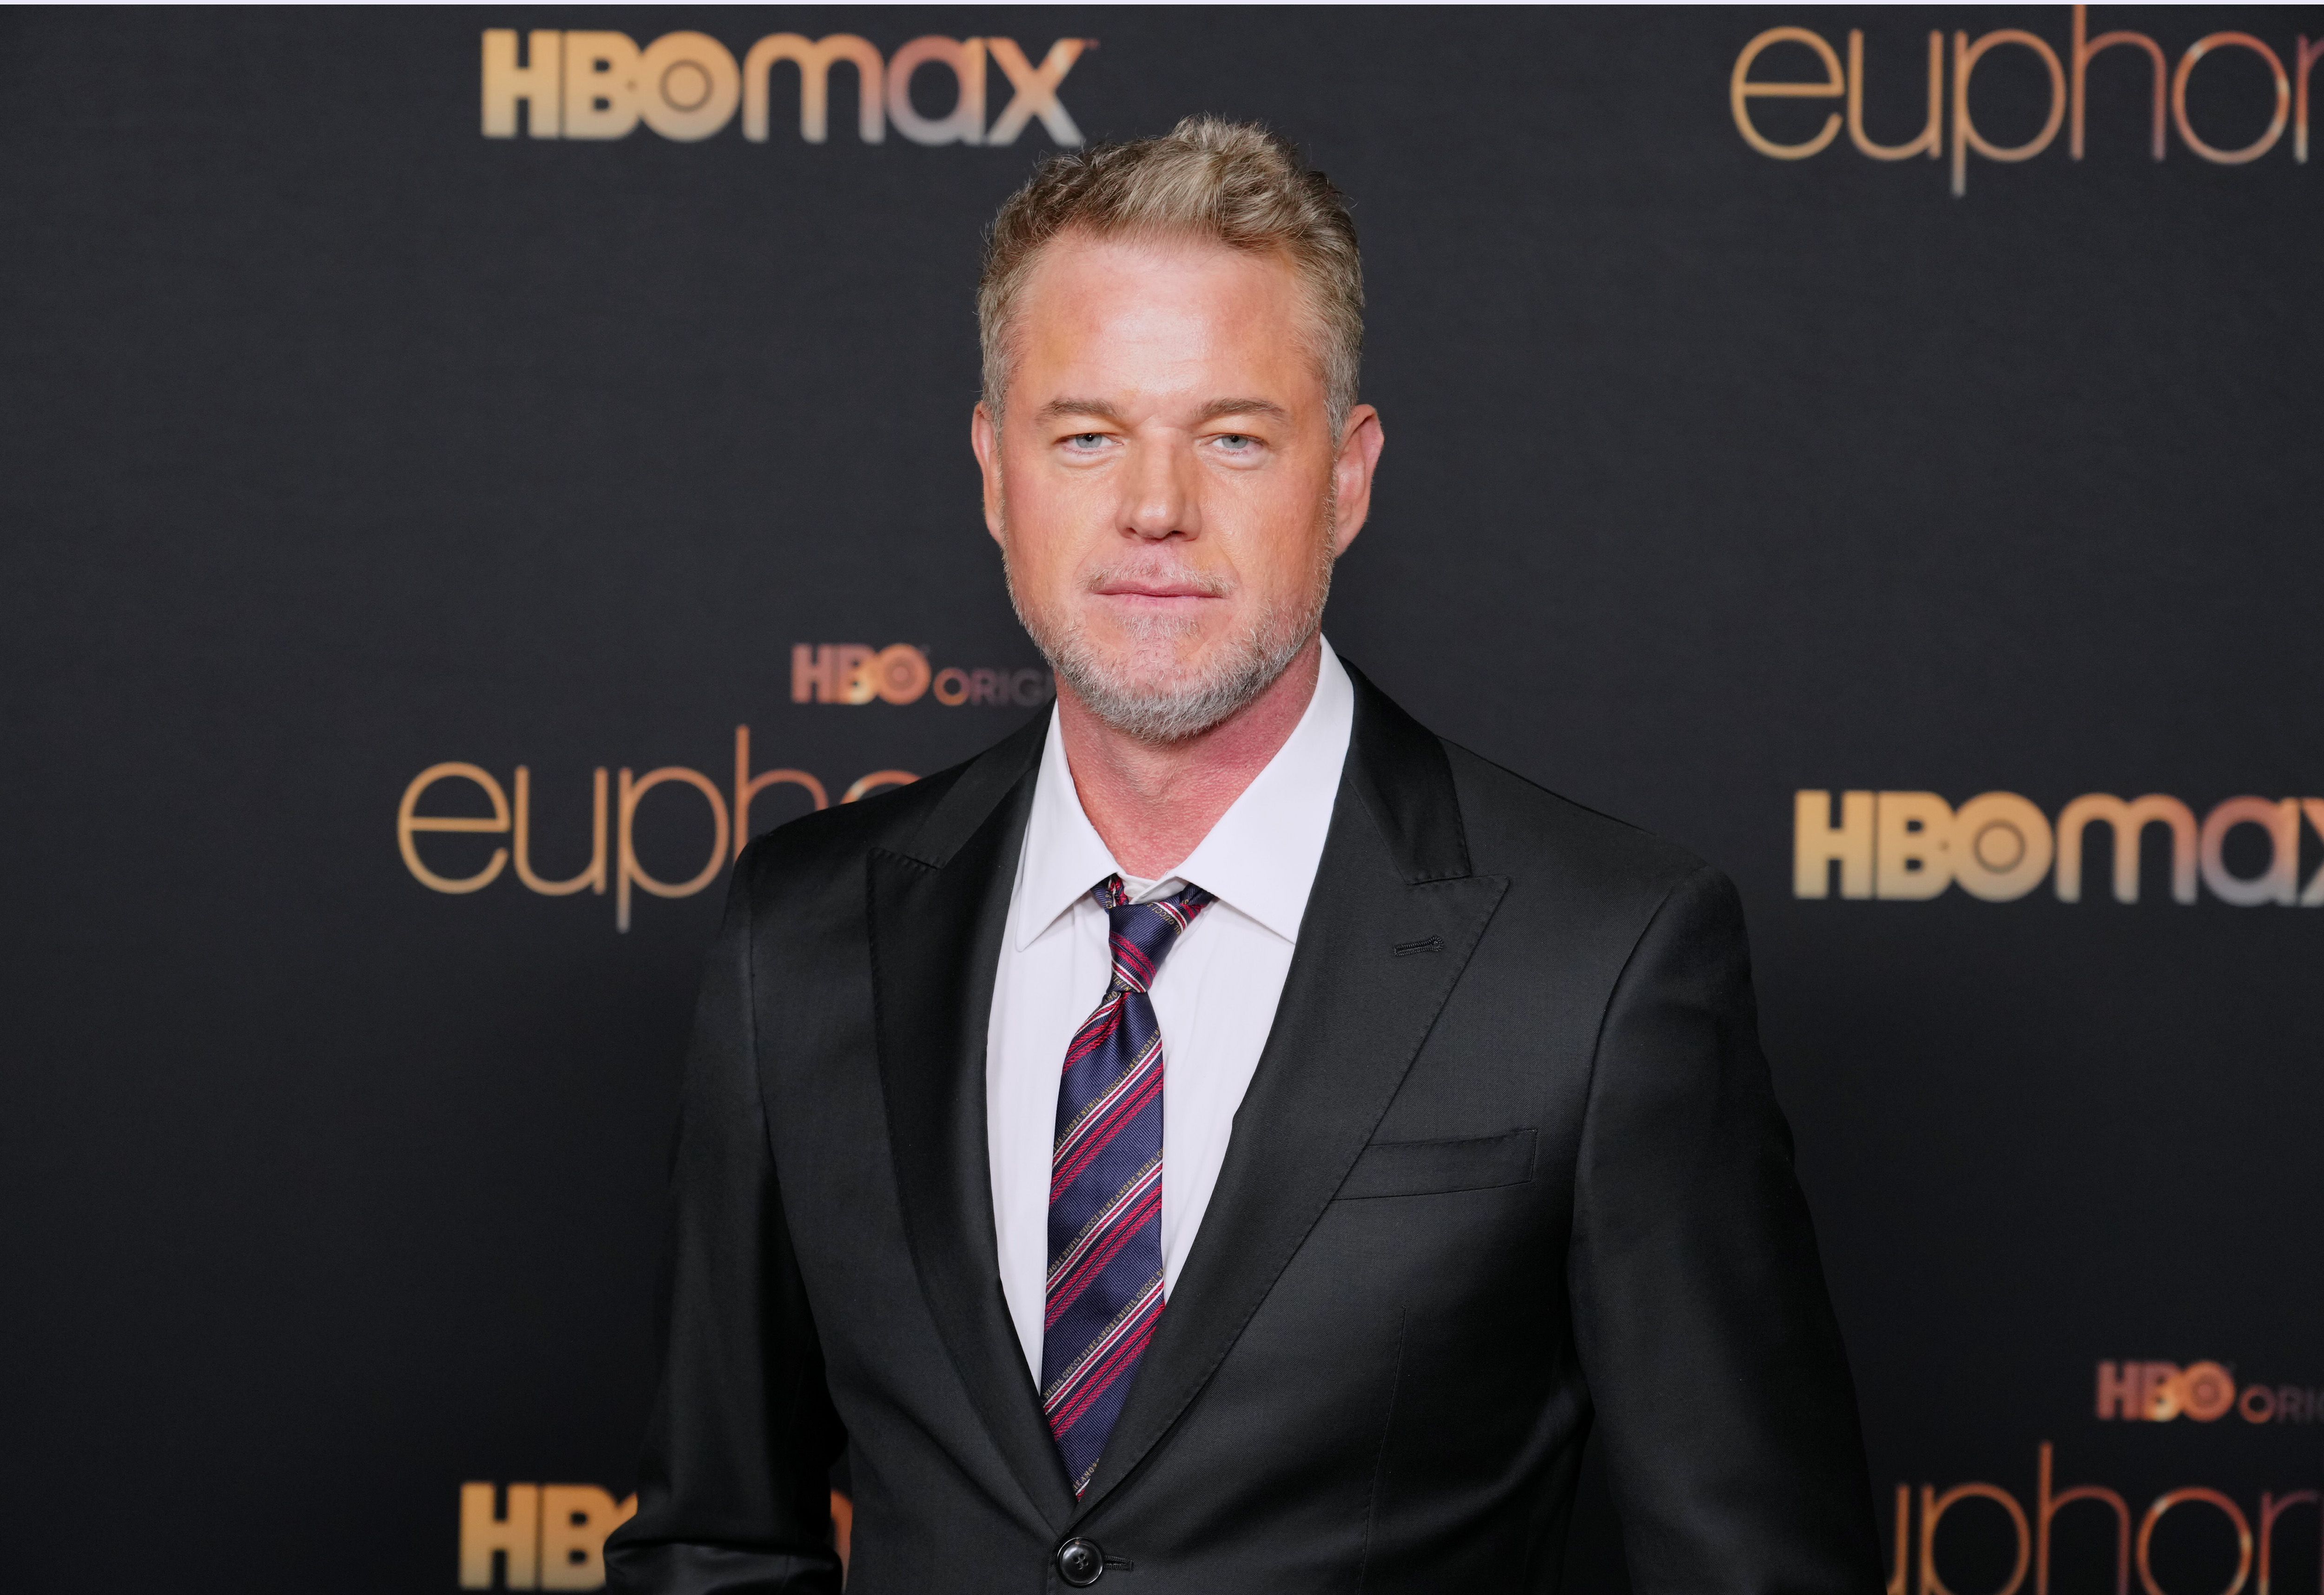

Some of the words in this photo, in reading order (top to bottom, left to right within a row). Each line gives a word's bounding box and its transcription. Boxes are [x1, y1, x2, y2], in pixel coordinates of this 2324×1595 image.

[792, 643, 931, 705] HBO
[398, 725, 921, 934] euph
[1794, 789, 2324, 907] HBOma
[1081, 1097, 1102, 1116] NIHIL
[1137, 1035, 1157, 1059] AMORE
[1079, 1215, 1100, 1236] GUCCI
[1099, 1198, 1116, 1215] SINE
[1116, 1176, 1137, 1199] AMORE
[1136, 1158, 1157, 1178] NIHIL
[1063, 1357, 1083, 1378] GUCCI
[1097, 1318, 1119, 1341] AMORE
[1117, 1299, 1137, 1319] NIHIL
[1136, 1276, 1158, 1298] GUCCI
[2097, 1360, 2235, 1422] HBO
[2238, 1384, 2324, 1424] ORI
[460, 1483, 638, 1590] HB
[1887, 1440, 2324, 1595] phor
